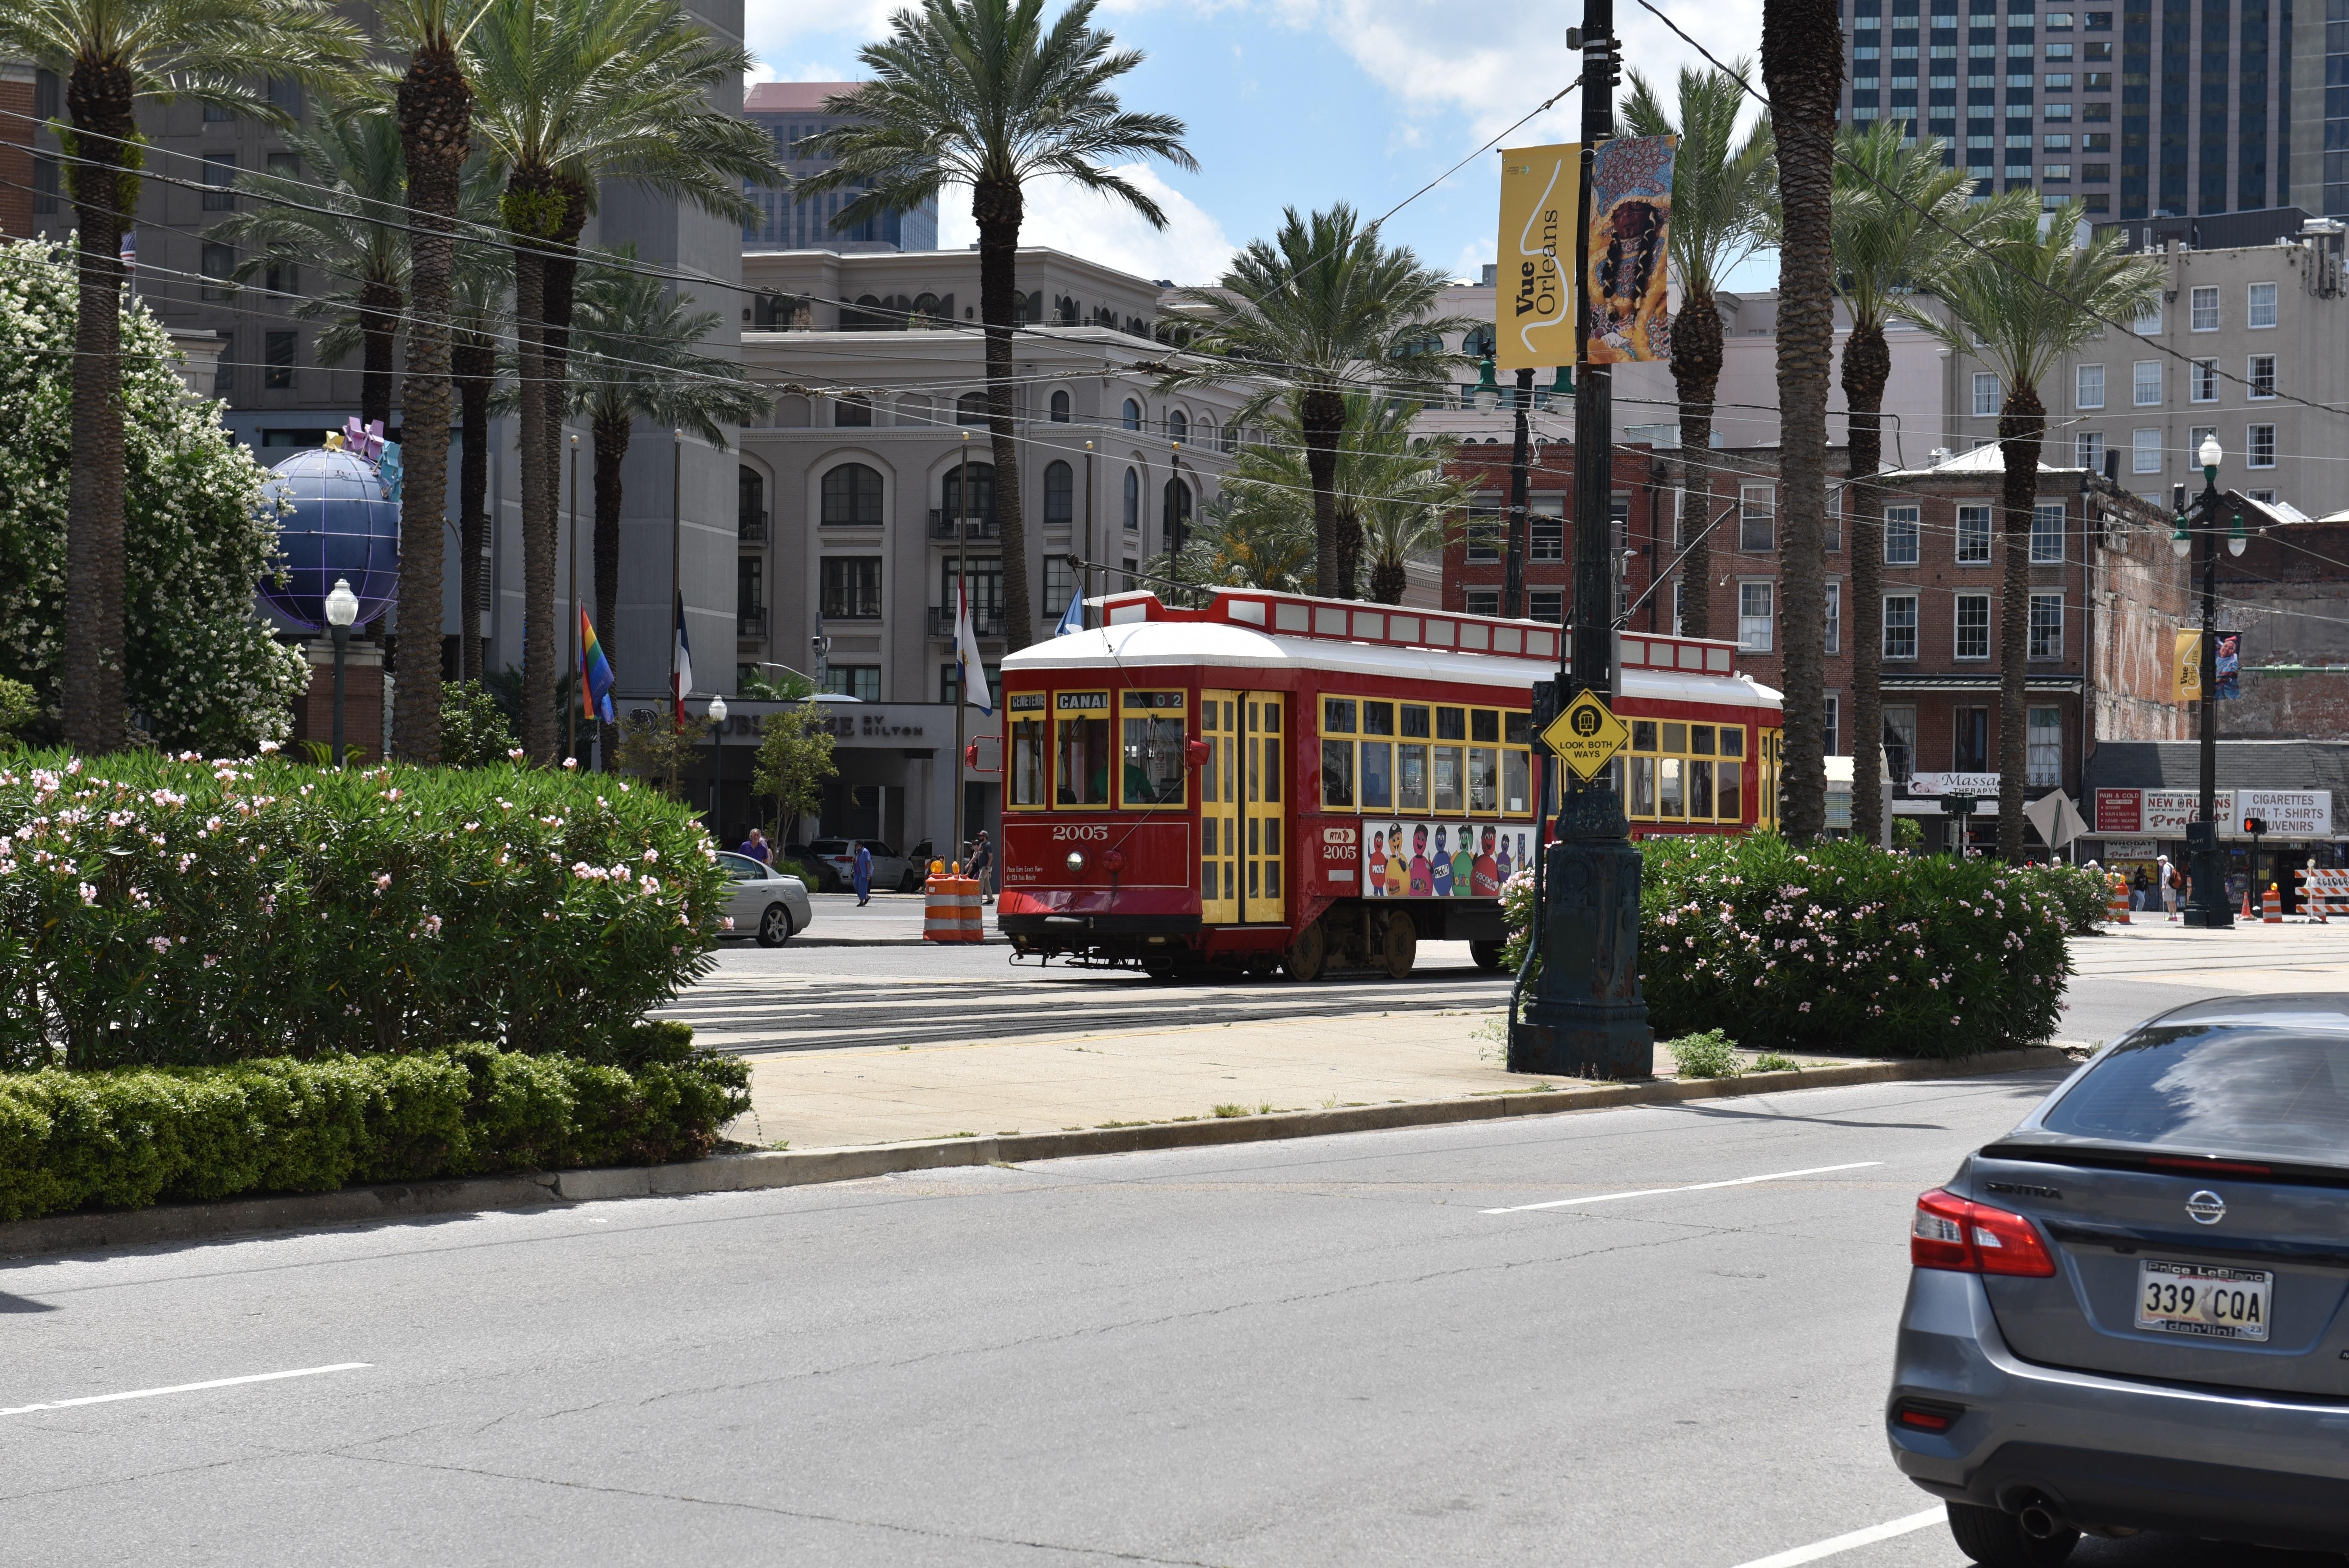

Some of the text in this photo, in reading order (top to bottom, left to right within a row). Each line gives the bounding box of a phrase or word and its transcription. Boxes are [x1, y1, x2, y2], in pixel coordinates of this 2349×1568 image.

[1536, 210, 1558, 315] Orleans
[1516, 262, 1535, 317] Vue
[2188, 650, 2198, 686] Orleans
[1059, 695, 1108, 708] CANAL
[864, 716, 884, 725] BY
[863, 727, 923, 736] HILTON
[2148, 798, 2231, 808] NEW ORLNS
[2253, 794, 2314, 805] CIGARETTES
[2149, 809, 2230, 827] Pralies
[2245, 807, 2265, 818] ATM
[1053, 825, 1108, 840] 2005
[2267, 821, 2314, 831] UVENIRS
[1330, 832, 1341, 840] RTA
[1323, 845, 1356, 859] 2005
[2110, 850, 2152, 858] Pralines
[1476, 871, 1493, 886] POWER
[1985, 1181, 2063, 1200] SENTRA
[2189, 1203, 2221, 1212] NISSAN
[2198, 1267, 2263, 1281] LeBlanc
[2146, 1283, 2260, 1322] 339 CQA
[2168, 1322, 2233, 1337] dah'lin!
